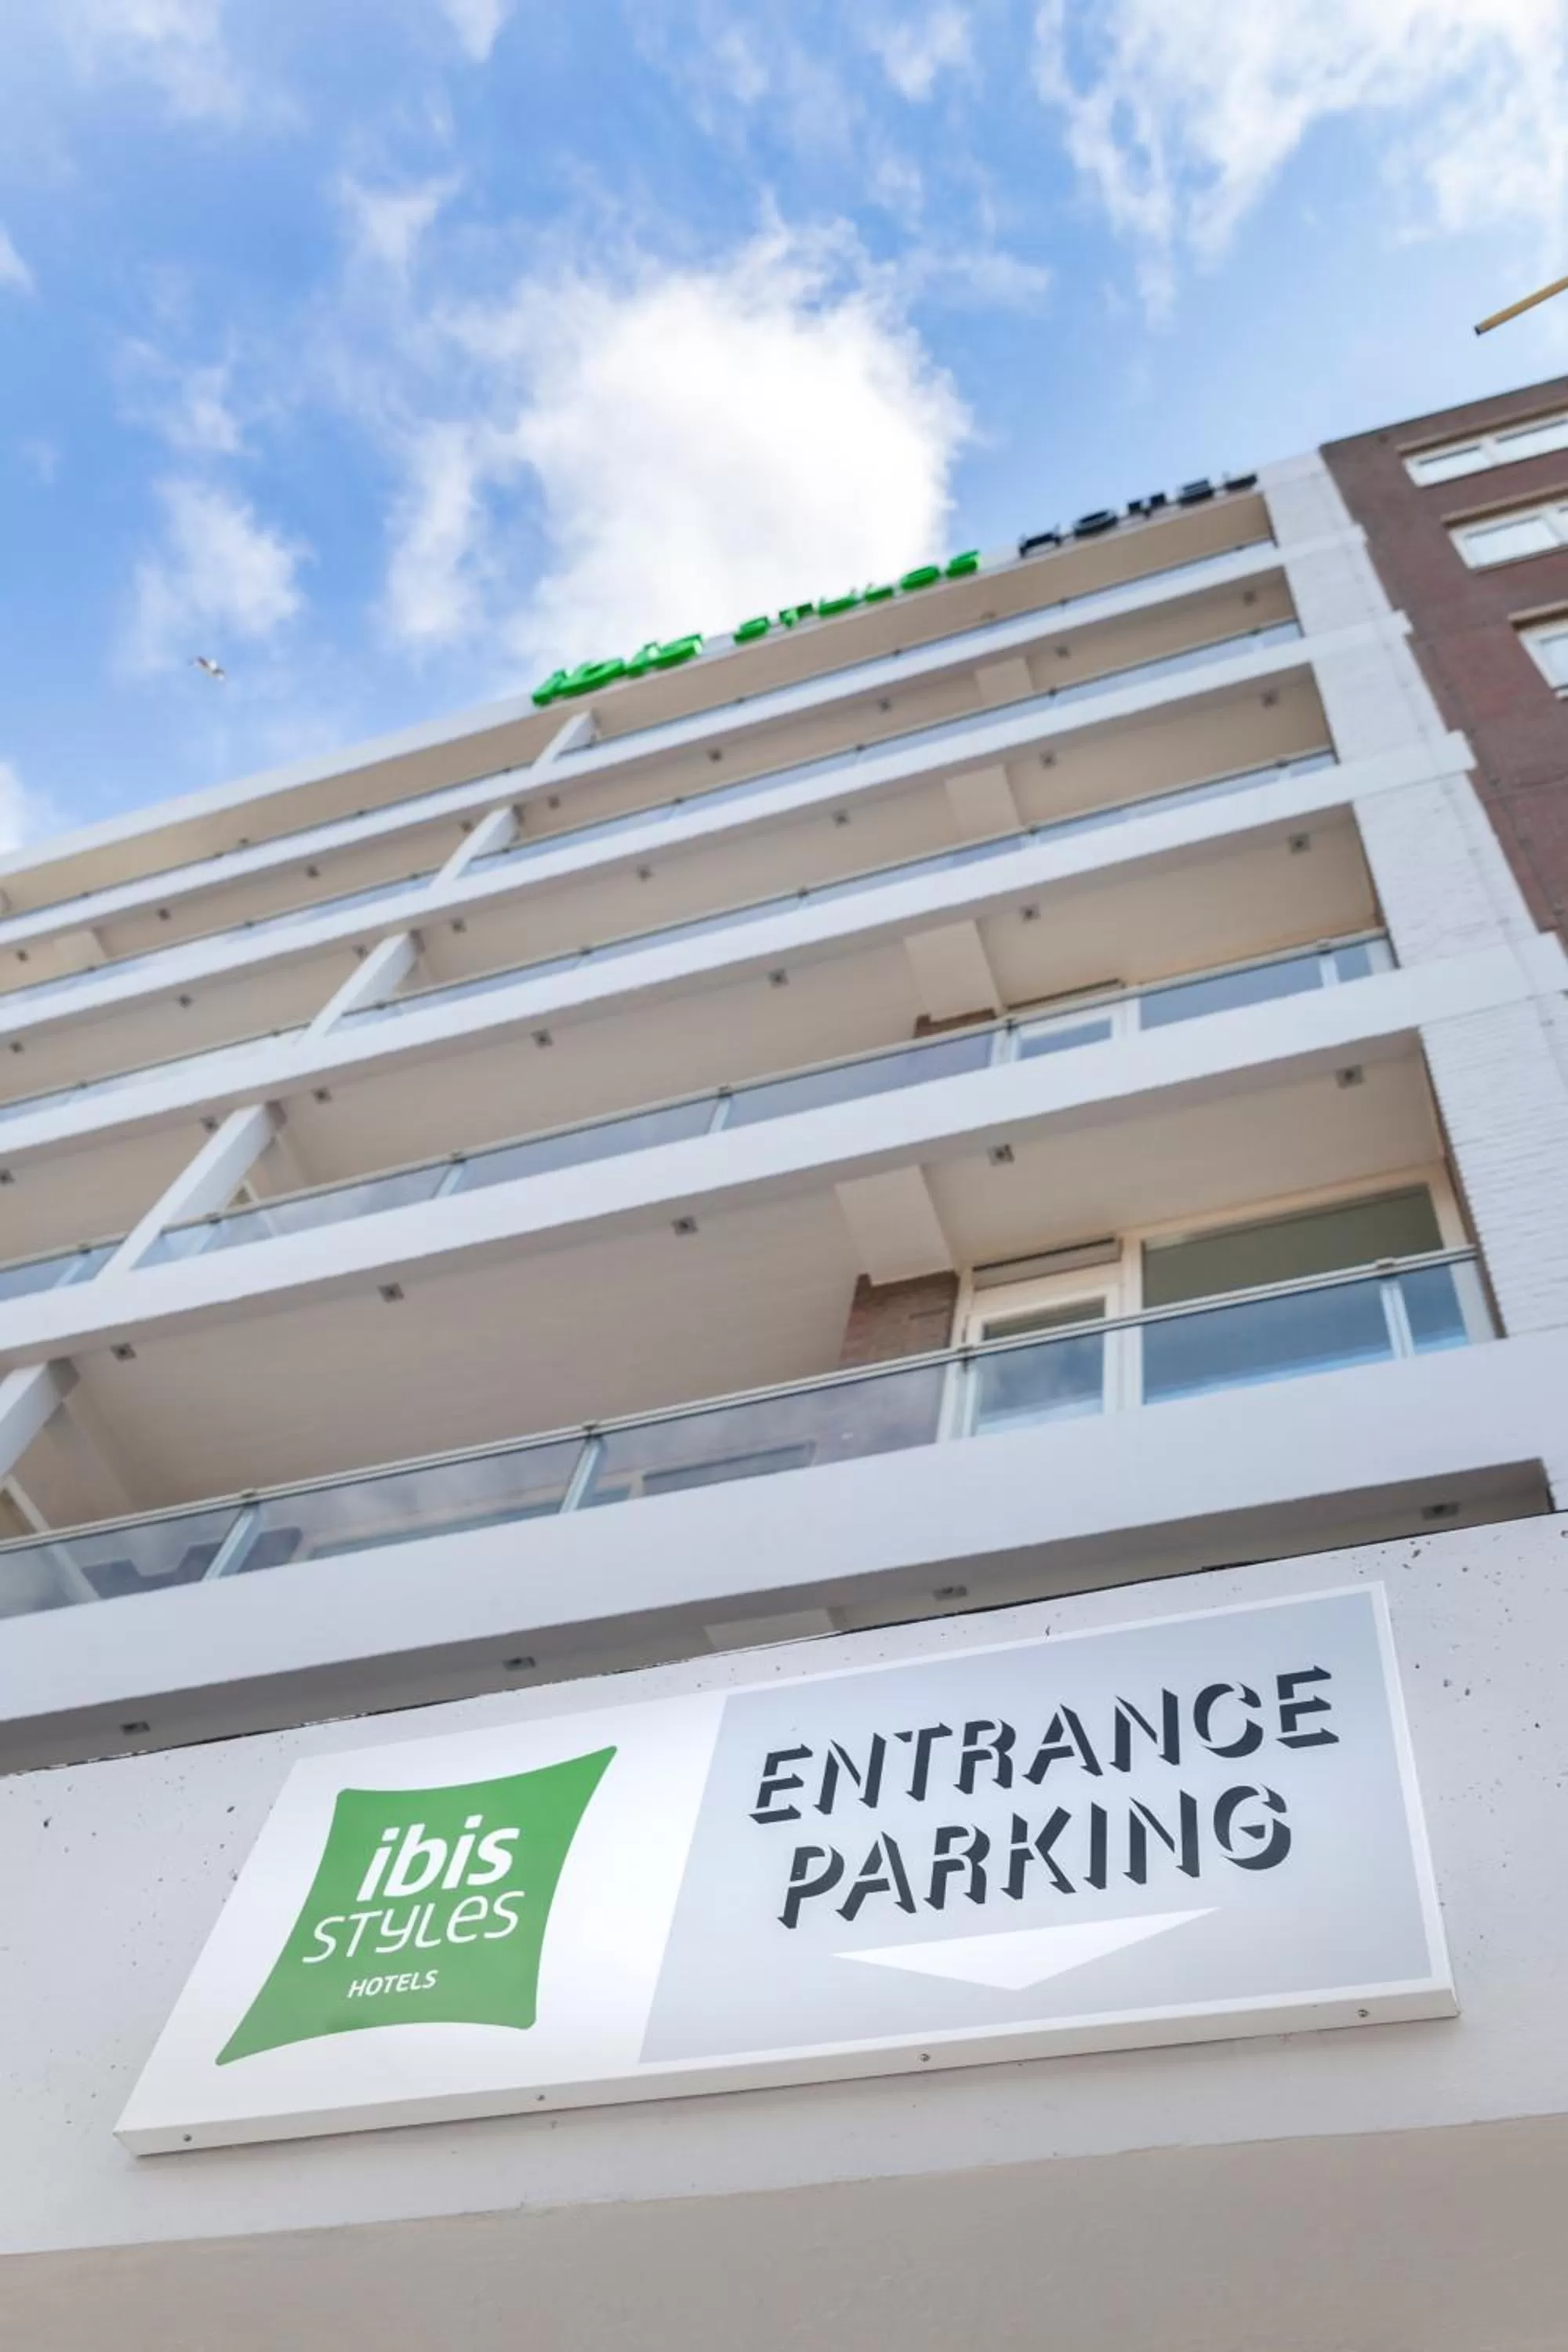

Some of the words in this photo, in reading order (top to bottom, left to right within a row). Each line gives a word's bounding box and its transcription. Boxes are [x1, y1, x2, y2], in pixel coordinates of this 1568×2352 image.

[748, 1664, 1340, 1824] ENTRANCE
[356, 1814, 521, 1902] ibis
[777, 1783, 1292, 1929] PARKING
[347, 1969, 440, 1999] HOTELS
